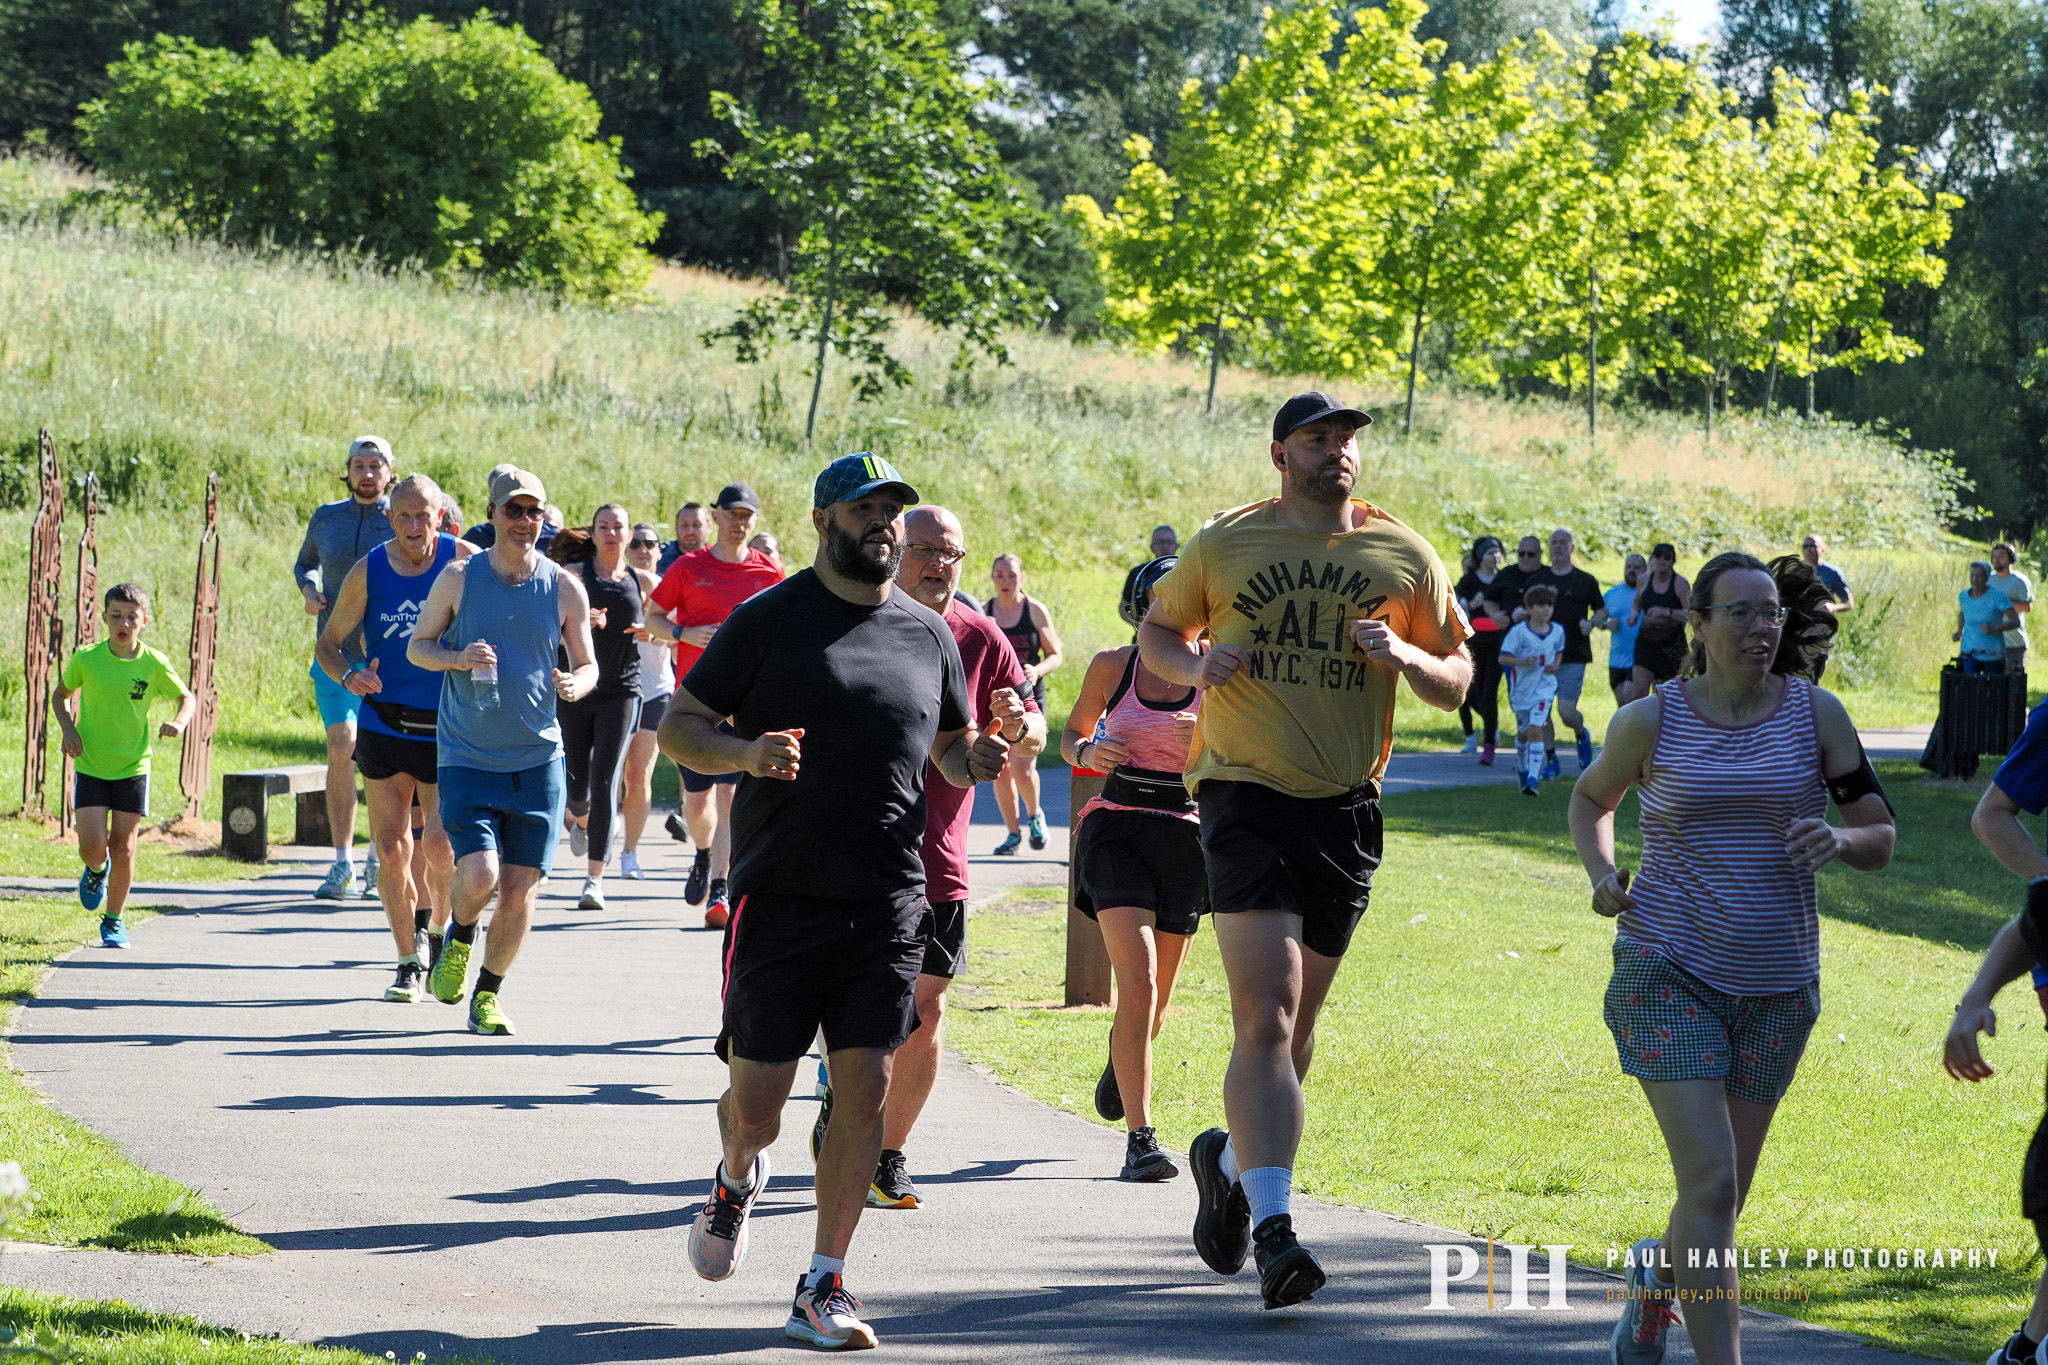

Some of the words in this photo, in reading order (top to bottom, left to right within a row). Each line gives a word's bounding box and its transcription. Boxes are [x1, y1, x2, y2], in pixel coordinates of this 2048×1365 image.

[380, 612, 419, 622] RunThr
[1276, 600, 1346, 652] ALI
[1250, 650, 1308, 685] N.Y.C.
[1320, 657, 1367, 692] 1974
